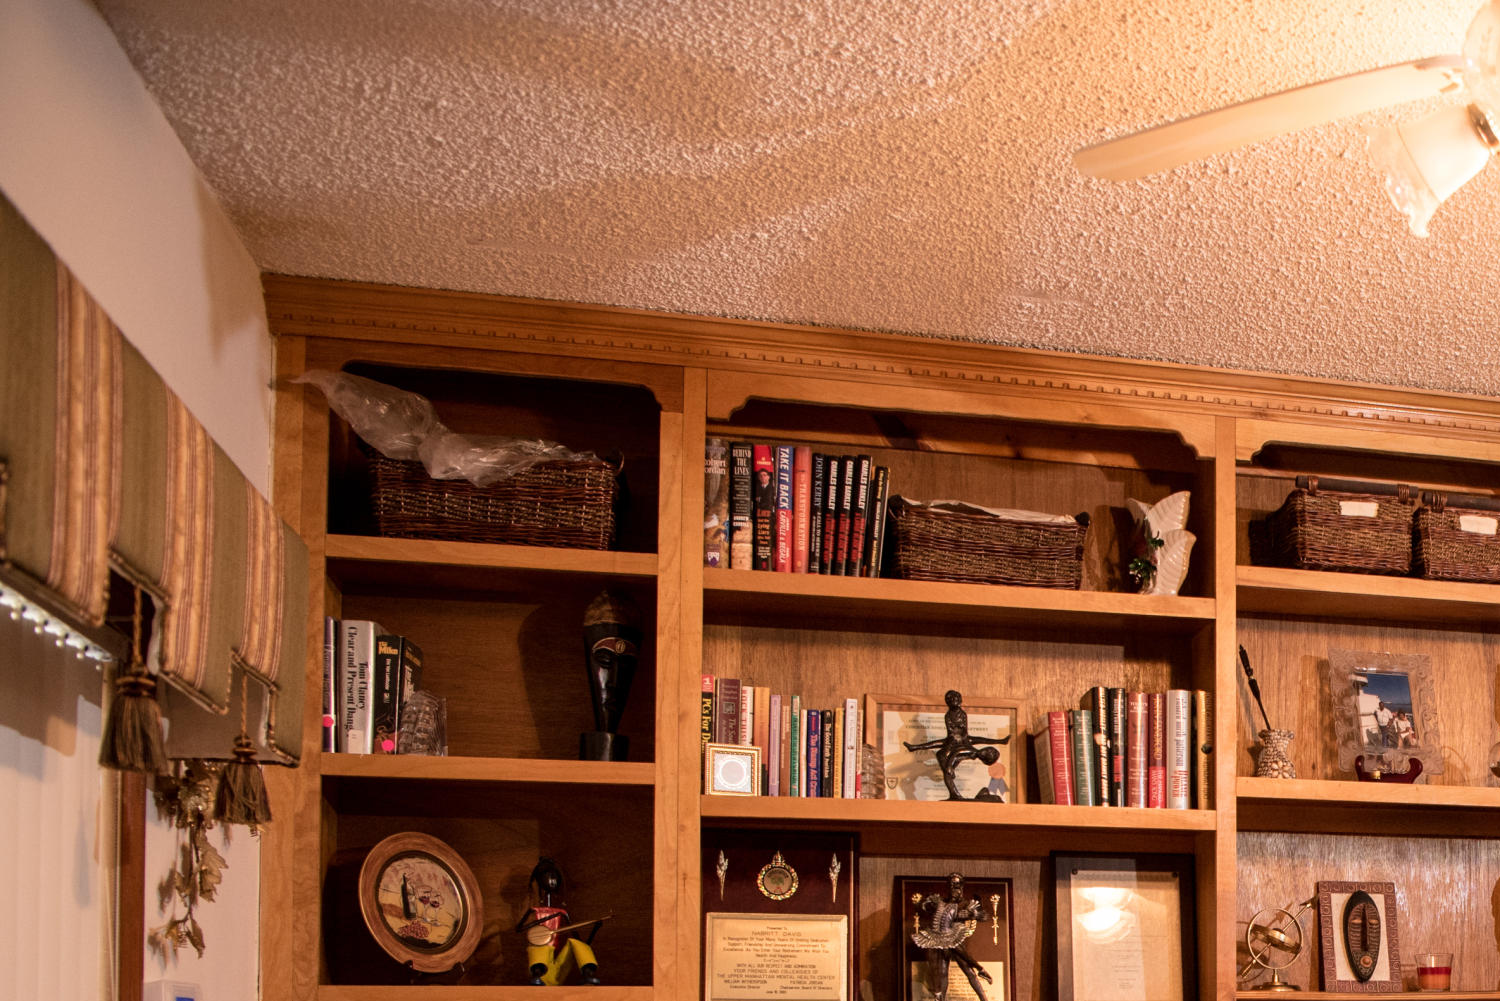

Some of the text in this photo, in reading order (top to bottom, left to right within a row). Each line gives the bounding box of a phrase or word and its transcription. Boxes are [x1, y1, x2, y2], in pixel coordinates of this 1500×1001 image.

[780, 448, 789, 509] TAKE IT BACK
[815, 457, 823, 478] JOHN
[828, 461, 838, 510] CHARLES BARKLEY
[843, 460, 854, 510] CHARLES BARKLEY
[858, 460, 869, 509] CHARLES BARKLEY
[799, 484, 807, 551] TRANSFORMATION
[813, 481, 822, 506] KERRY
[344, 627, 357, 731] Clear and Present Dang
[356, 662, 368, 711] Tom Clancy
[703, 698, 711, 713] PCs
[703, 716, 711, 730] For
